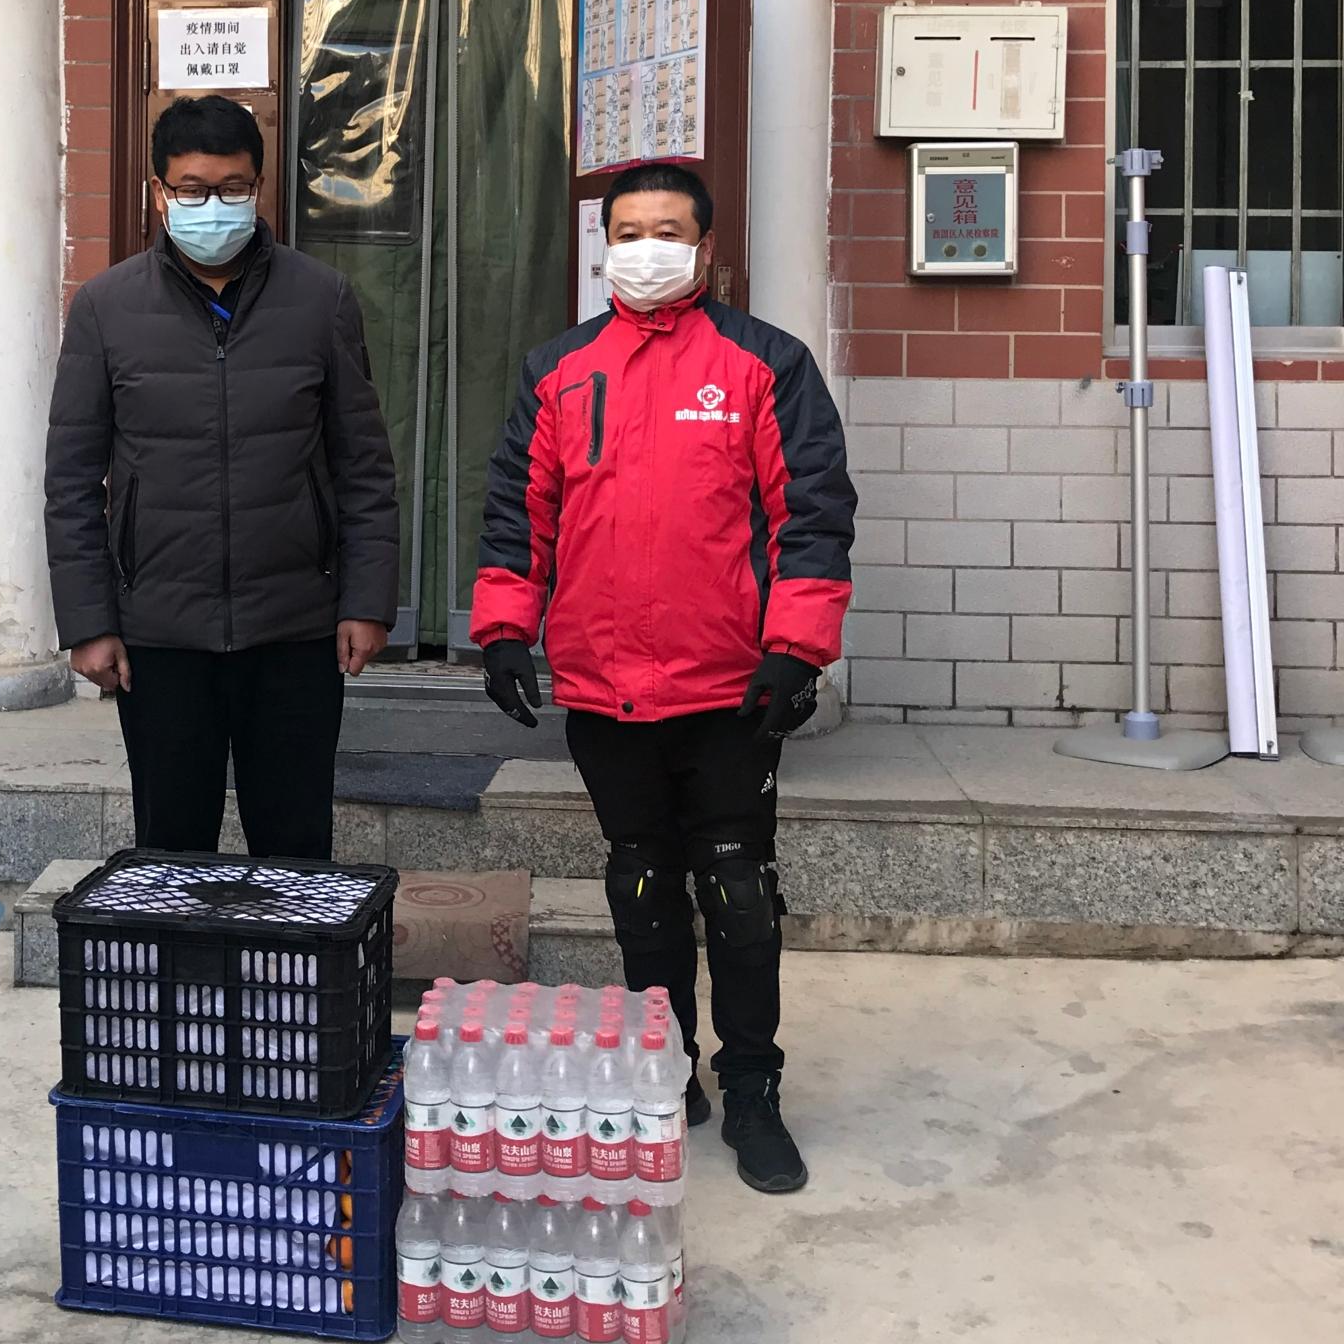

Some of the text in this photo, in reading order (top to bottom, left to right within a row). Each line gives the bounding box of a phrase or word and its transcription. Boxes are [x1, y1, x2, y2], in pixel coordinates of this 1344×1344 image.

[186, 21, 241, 35] 疫情期间
[179, 41, 247, 56] 出入请自觉
[186, 62, 241, 77] 佩戴口罩
[952, 178, 978, 225] 意见箱
[932, 228, 1000, 240] 西固区人民检察院
[501, 1144, 538, 1156] 农夫山泉
[417, 1292, 441, 1304] 农夫
